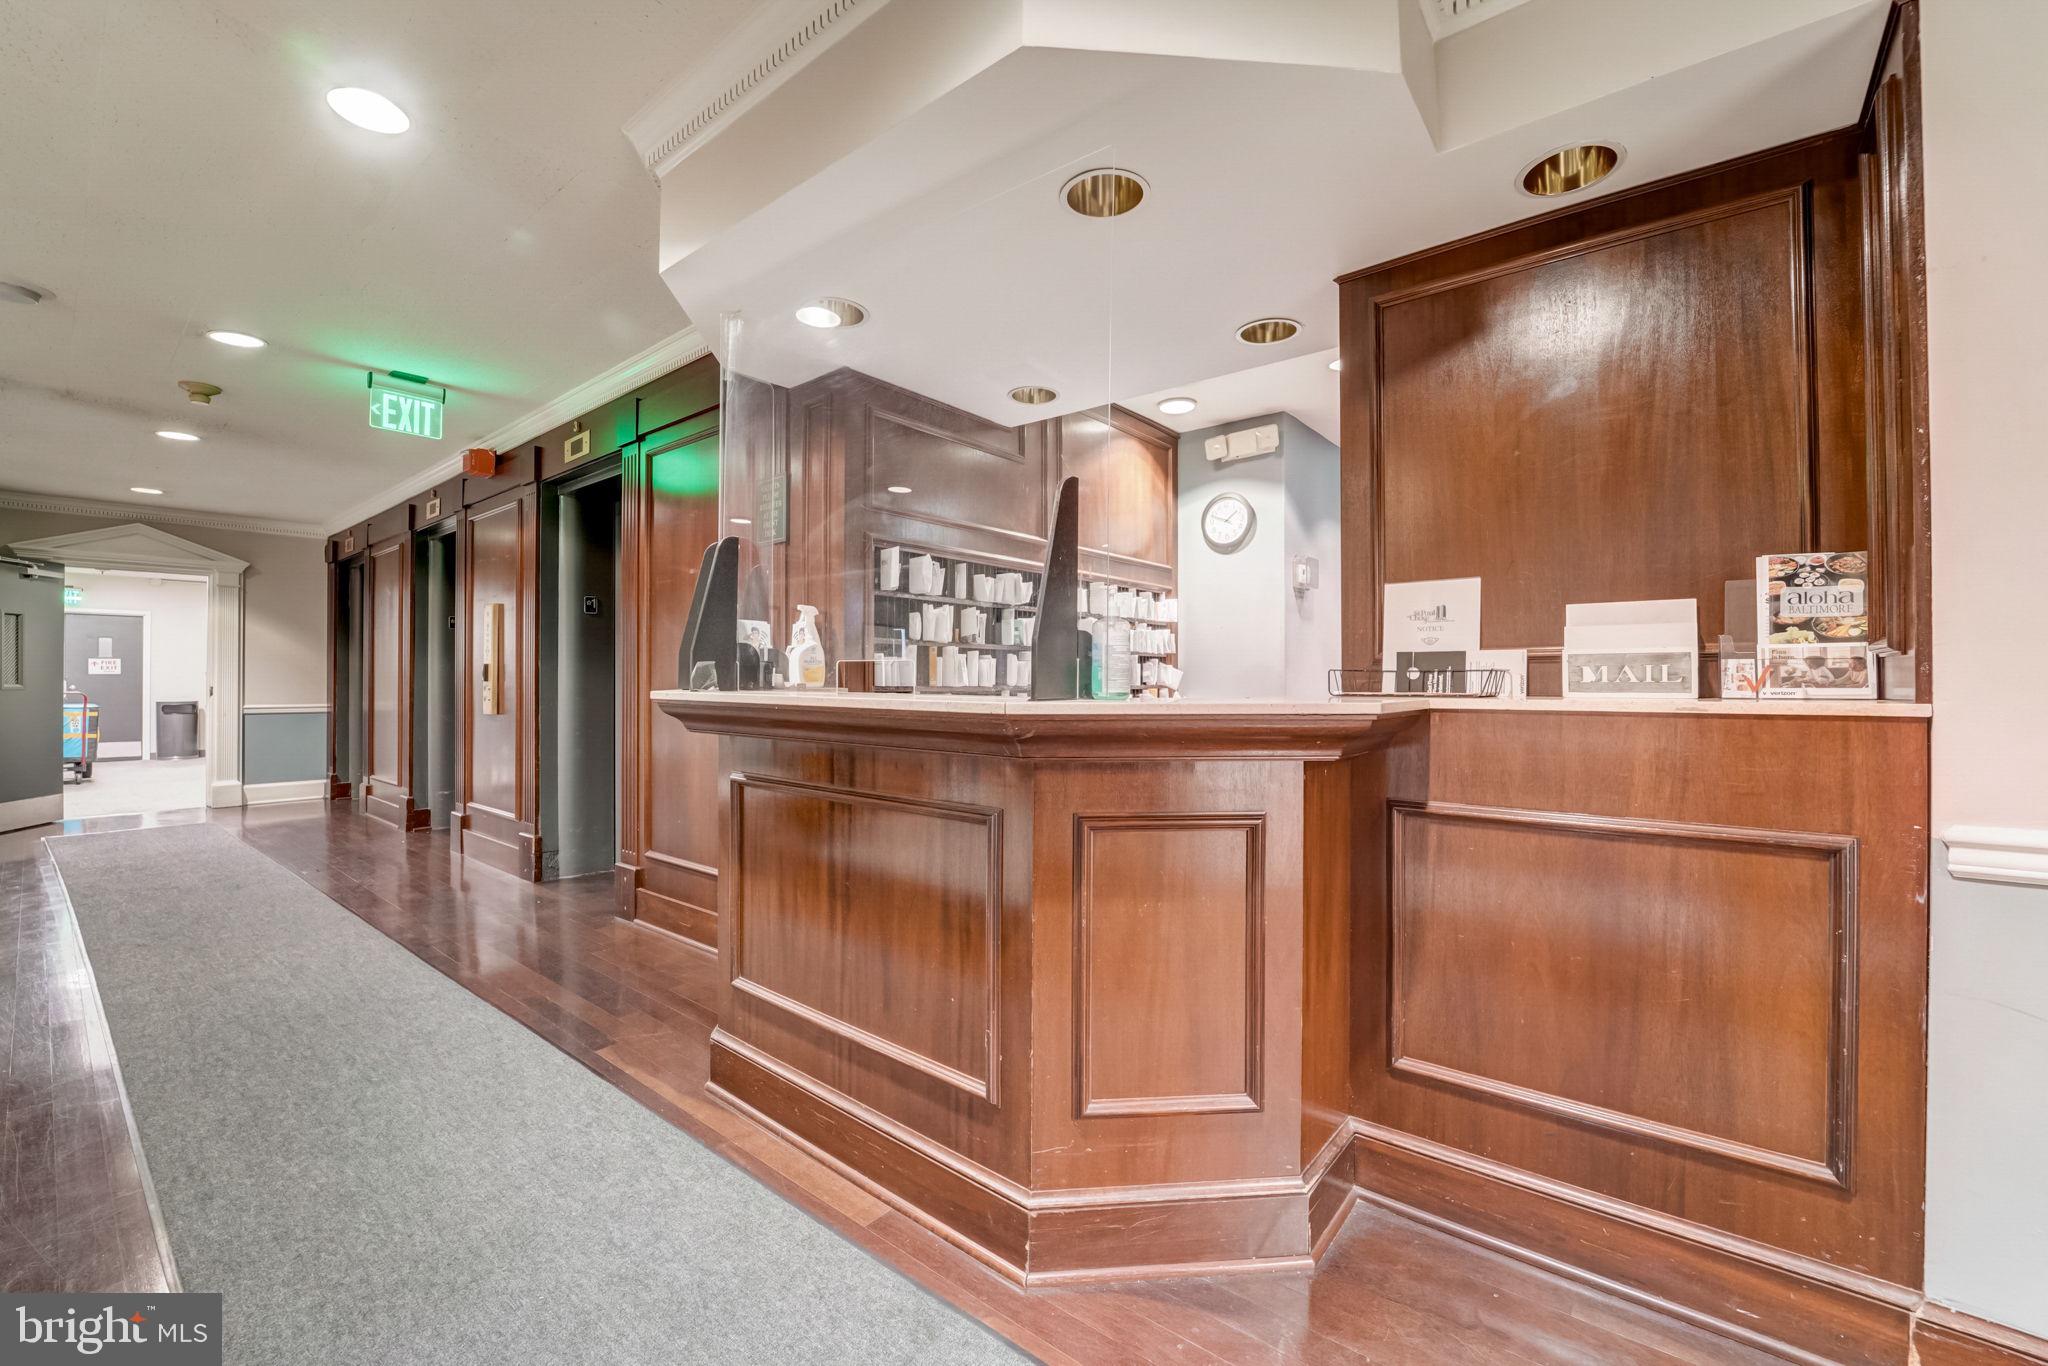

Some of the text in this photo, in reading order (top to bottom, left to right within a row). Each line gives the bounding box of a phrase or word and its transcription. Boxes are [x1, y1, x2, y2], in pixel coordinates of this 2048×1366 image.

[382, 393, 435, 436] EXIT
[1787, 590, 1855, 605] aloha
[1788, 603, 1854, 614] BALTIMORE
[1580, 664, 1683, 683] MAIL
